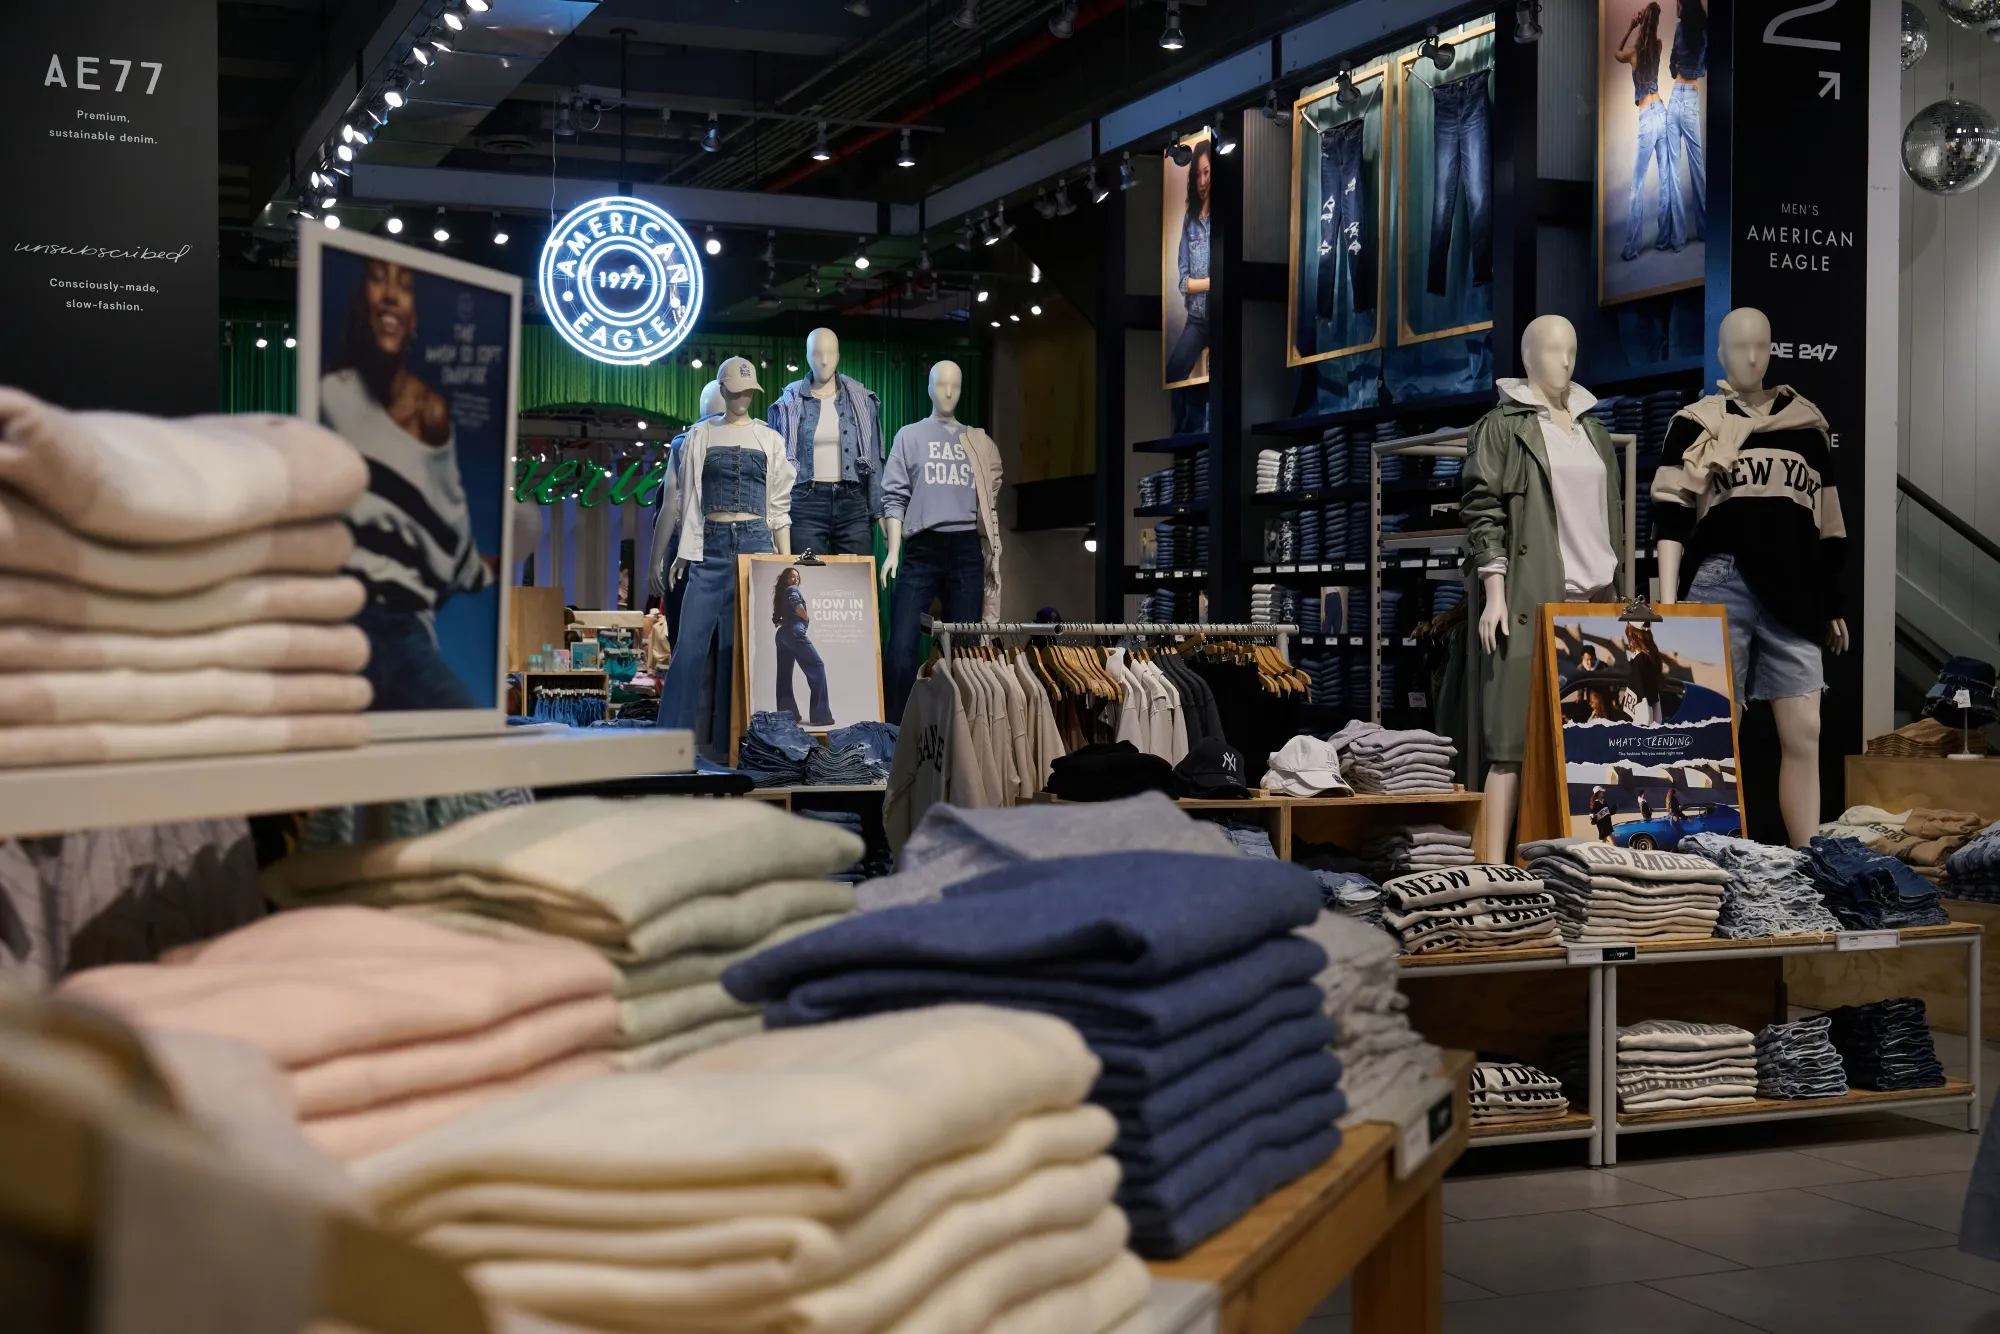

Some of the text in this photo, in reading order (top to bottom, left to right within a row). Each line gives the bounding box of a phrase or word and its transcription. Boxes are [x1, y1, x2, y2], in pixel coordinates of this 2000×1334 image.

[44, 53, 163, 95] AE77
[77, 109, 130, 124] Premium,
[49, 129, 158, 145] sustainable denim.
[1781, 202, 1819, 216] MEN'S
[1746, 224, 1853, 248] AMERICAN
[14, 242, 191, 263] unsubscribed
[556, 212, 689, 284] AMERICAN
[1769, 252, 1830, 272] EAGLE
[49, 278, 160, 294] Consciously-made,
[599, 271, 646, 291] 1977
[65, 299, 144, 312] slow-fashion.
[572, 311, 671, 351] EAGLE
[1798, 342, 1838, 362] 24/7
[927, 441, 967, 461] EAS
[924, 461, 976, 489] COAS
[811, 598, 864, 610] NOW IN
[813, 610, 863, 621] CURVY!
[1608, 736, 1691, 749] WHAT'S TRENDING
[1392, 868, 1471, 898] NEW
